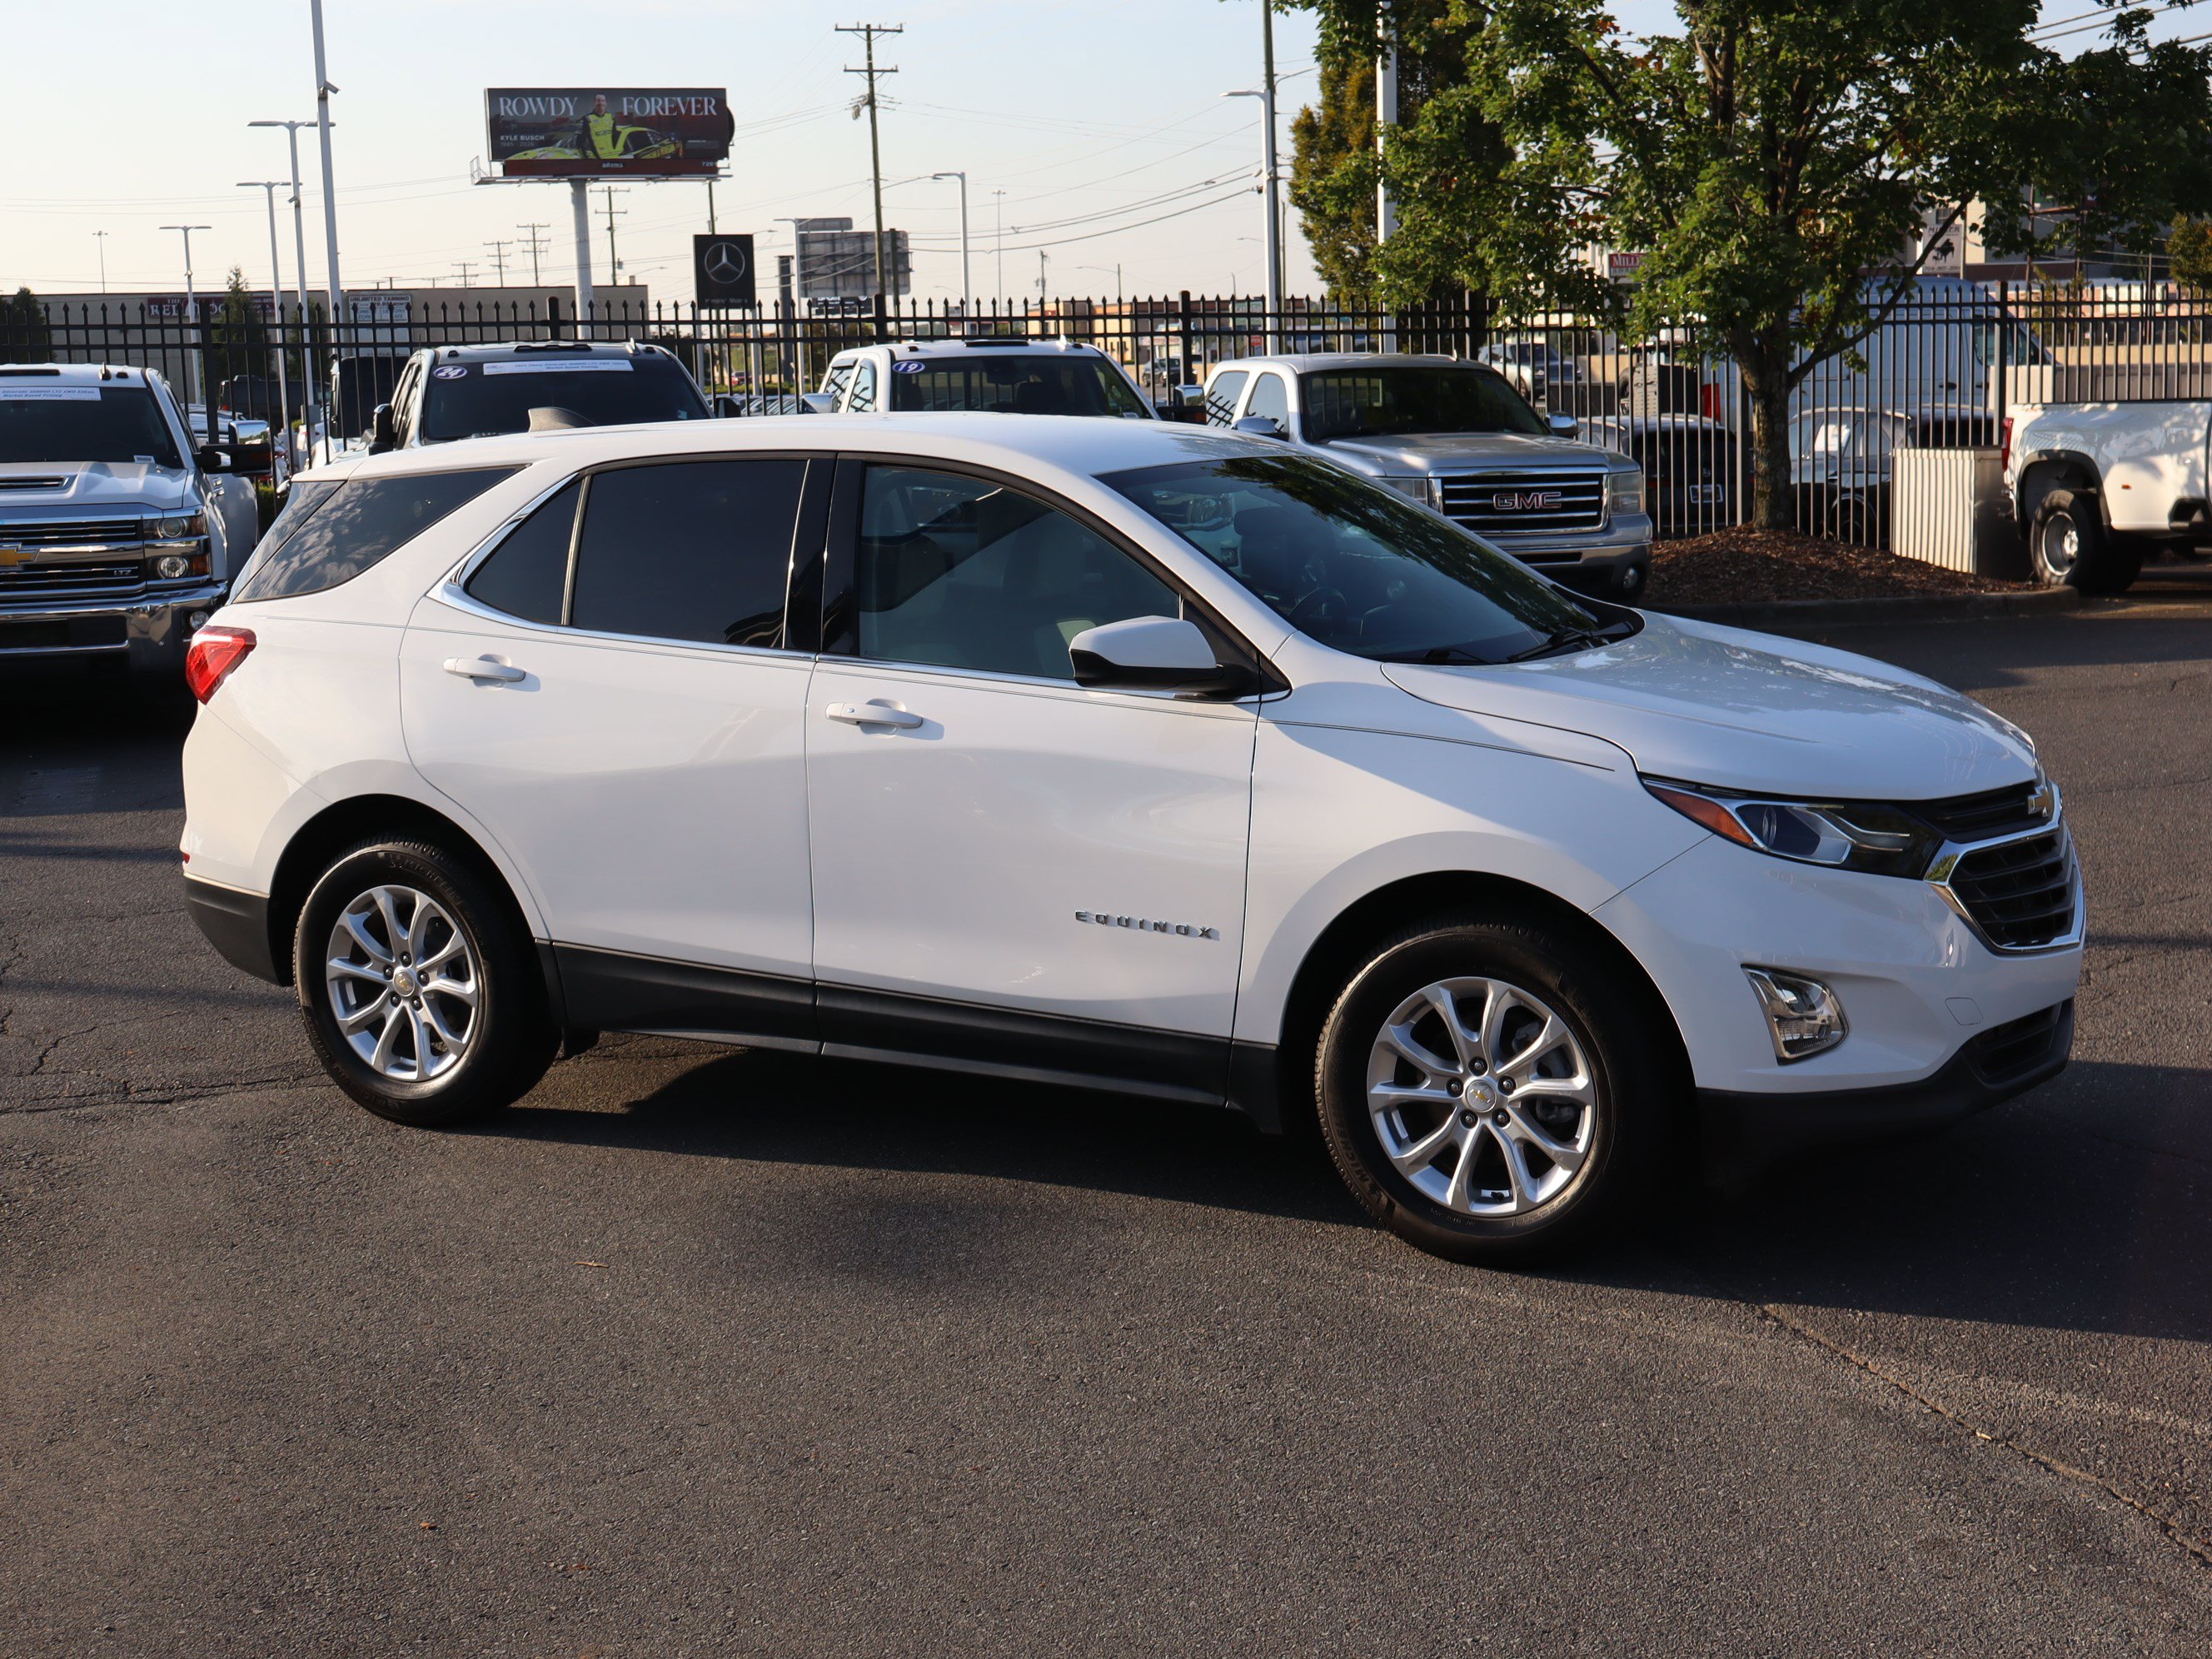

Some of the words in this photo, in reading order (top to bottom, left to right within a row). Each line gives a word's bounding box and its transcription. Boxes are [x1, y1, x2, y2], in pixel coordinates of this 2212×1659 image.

[499, 97, 578, 117] ROWDY
[623, 97, 718, 116] FOREVER
[438, 367, 459, 377] 24
[898, 362, 919, 372] 19
[1492, 491, 1562, 510] GMC
[1074, 909, 1213, 939] EQUINOX
